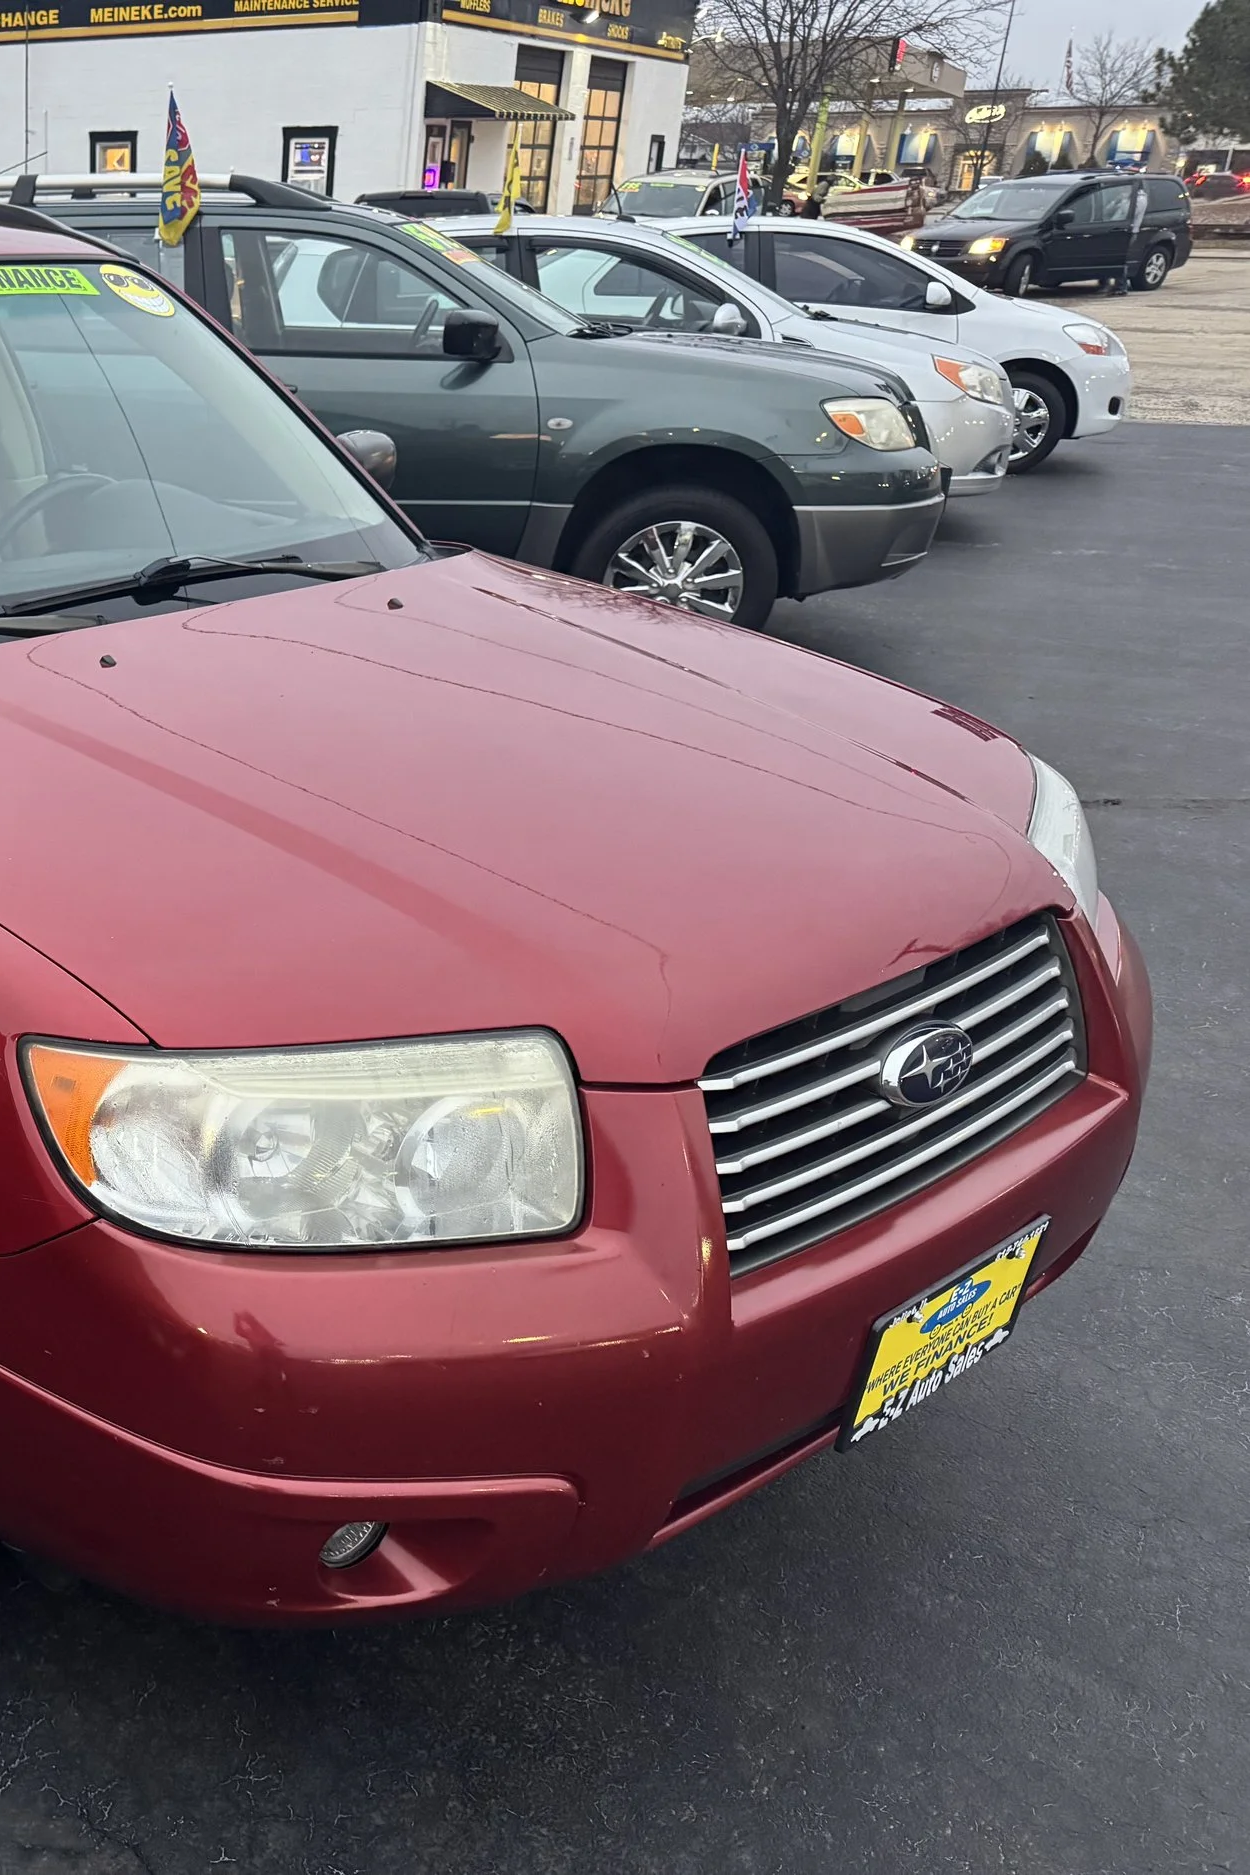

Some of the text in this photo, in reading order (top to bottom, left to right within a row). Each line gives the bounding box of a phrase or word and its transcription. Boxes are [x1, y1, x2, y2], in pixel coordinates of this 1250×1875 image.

[90, 4, 203, 23] MEINEKE.com
[234, 0, 310, 12] MAINTENANCE
[538, 8, 565, 28] BRAKES
[937, 1288, 979, 1320] AUTO SALES
[950, 1279, 973, 1303] E-Z
[904, 1330, 952, 1367] EVERYONE
[952, 1314, 973, 1338] CAN
[971, 1304, 992, 1326] BUY
[882, 1312, 995, 1396] WE FINANCE!
[905, 1370, 943, 1411] Auto
[943, 1341, 986, 1384] Sales
